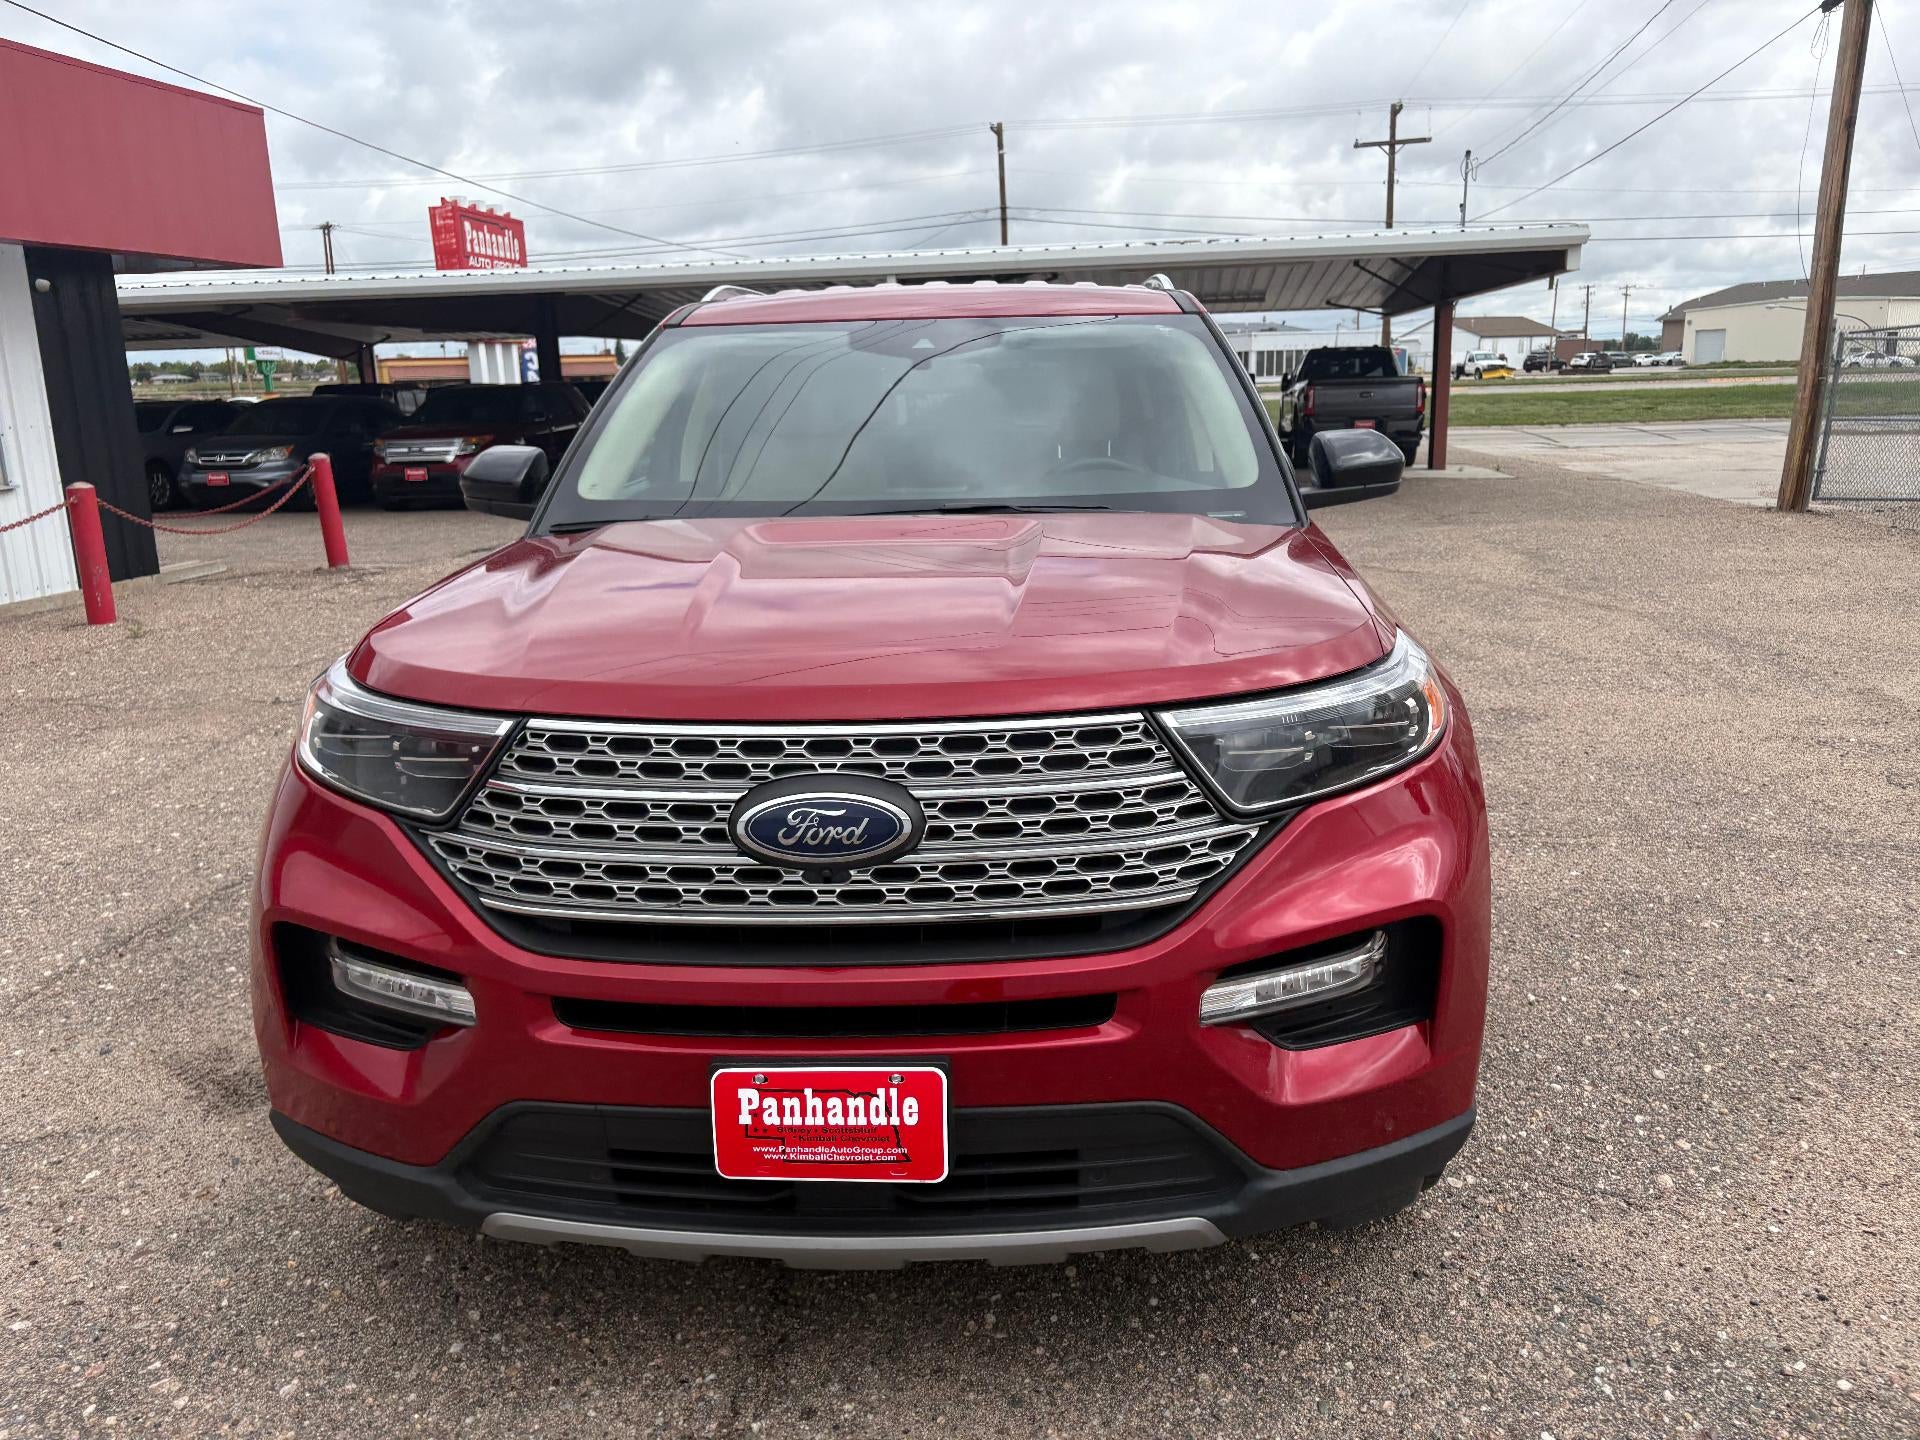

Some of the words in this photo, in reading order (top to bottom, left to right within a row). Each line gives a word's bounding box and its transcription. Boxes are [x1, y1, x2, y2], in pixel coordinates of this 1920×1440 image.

[464, 220, 520, 262] Panhandle
[469, 256, 491, 269] AUTO
[777, 807, 870, 846] Ford
[737, 1087, 919, 1126] Panhandle
[776, 1126, 812, 1135] Sidney
[798, 1134, 837, 1142] Kimball
[841, 1135, 890, 1143] Chevrolet
[752, 1145, 908, 1155] www.PanhandleAutoGroup.com
[763, 1152, 897, 1162] www.KimballChevrolet.com
